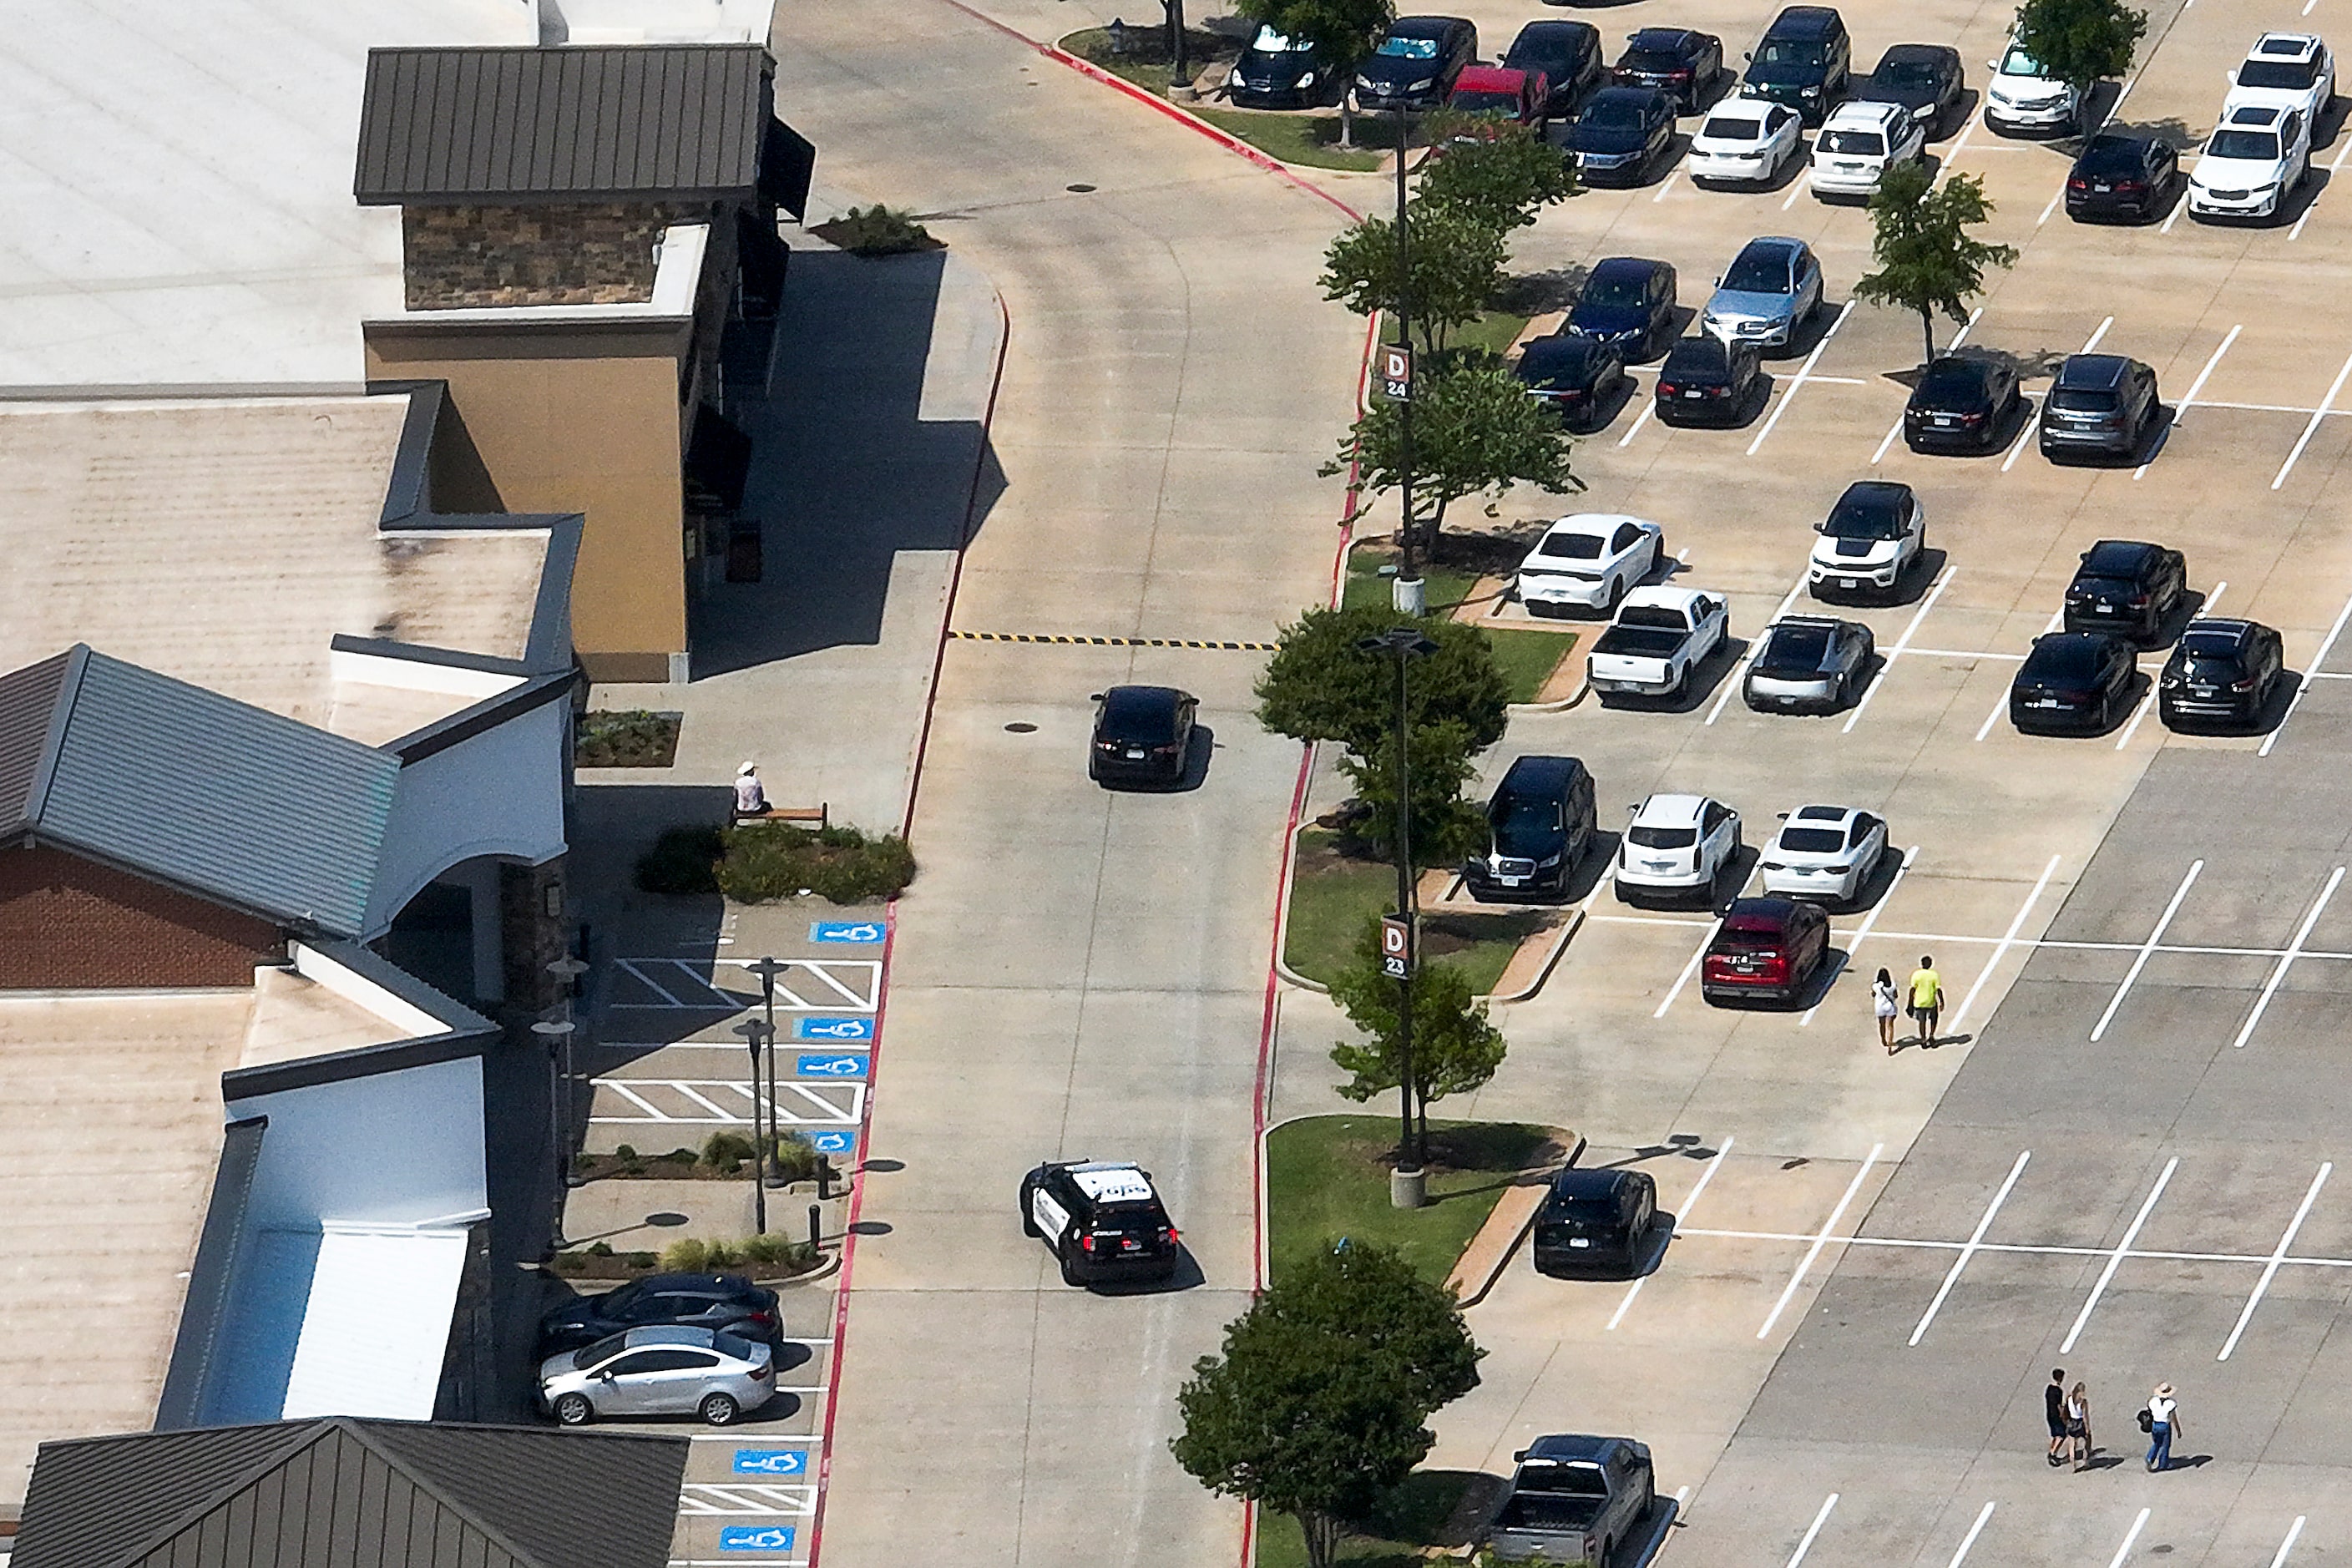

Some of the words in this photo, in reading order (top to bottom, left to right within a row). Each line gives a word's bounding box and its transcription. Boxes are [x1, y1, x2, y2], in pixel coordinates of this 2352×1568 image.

[1389, 354, 1404, 377] D
[1388, 382, 1406, 397] 24
[1387, 928, 1403, 952] D
[1386, 957, 1404, 974] 23
